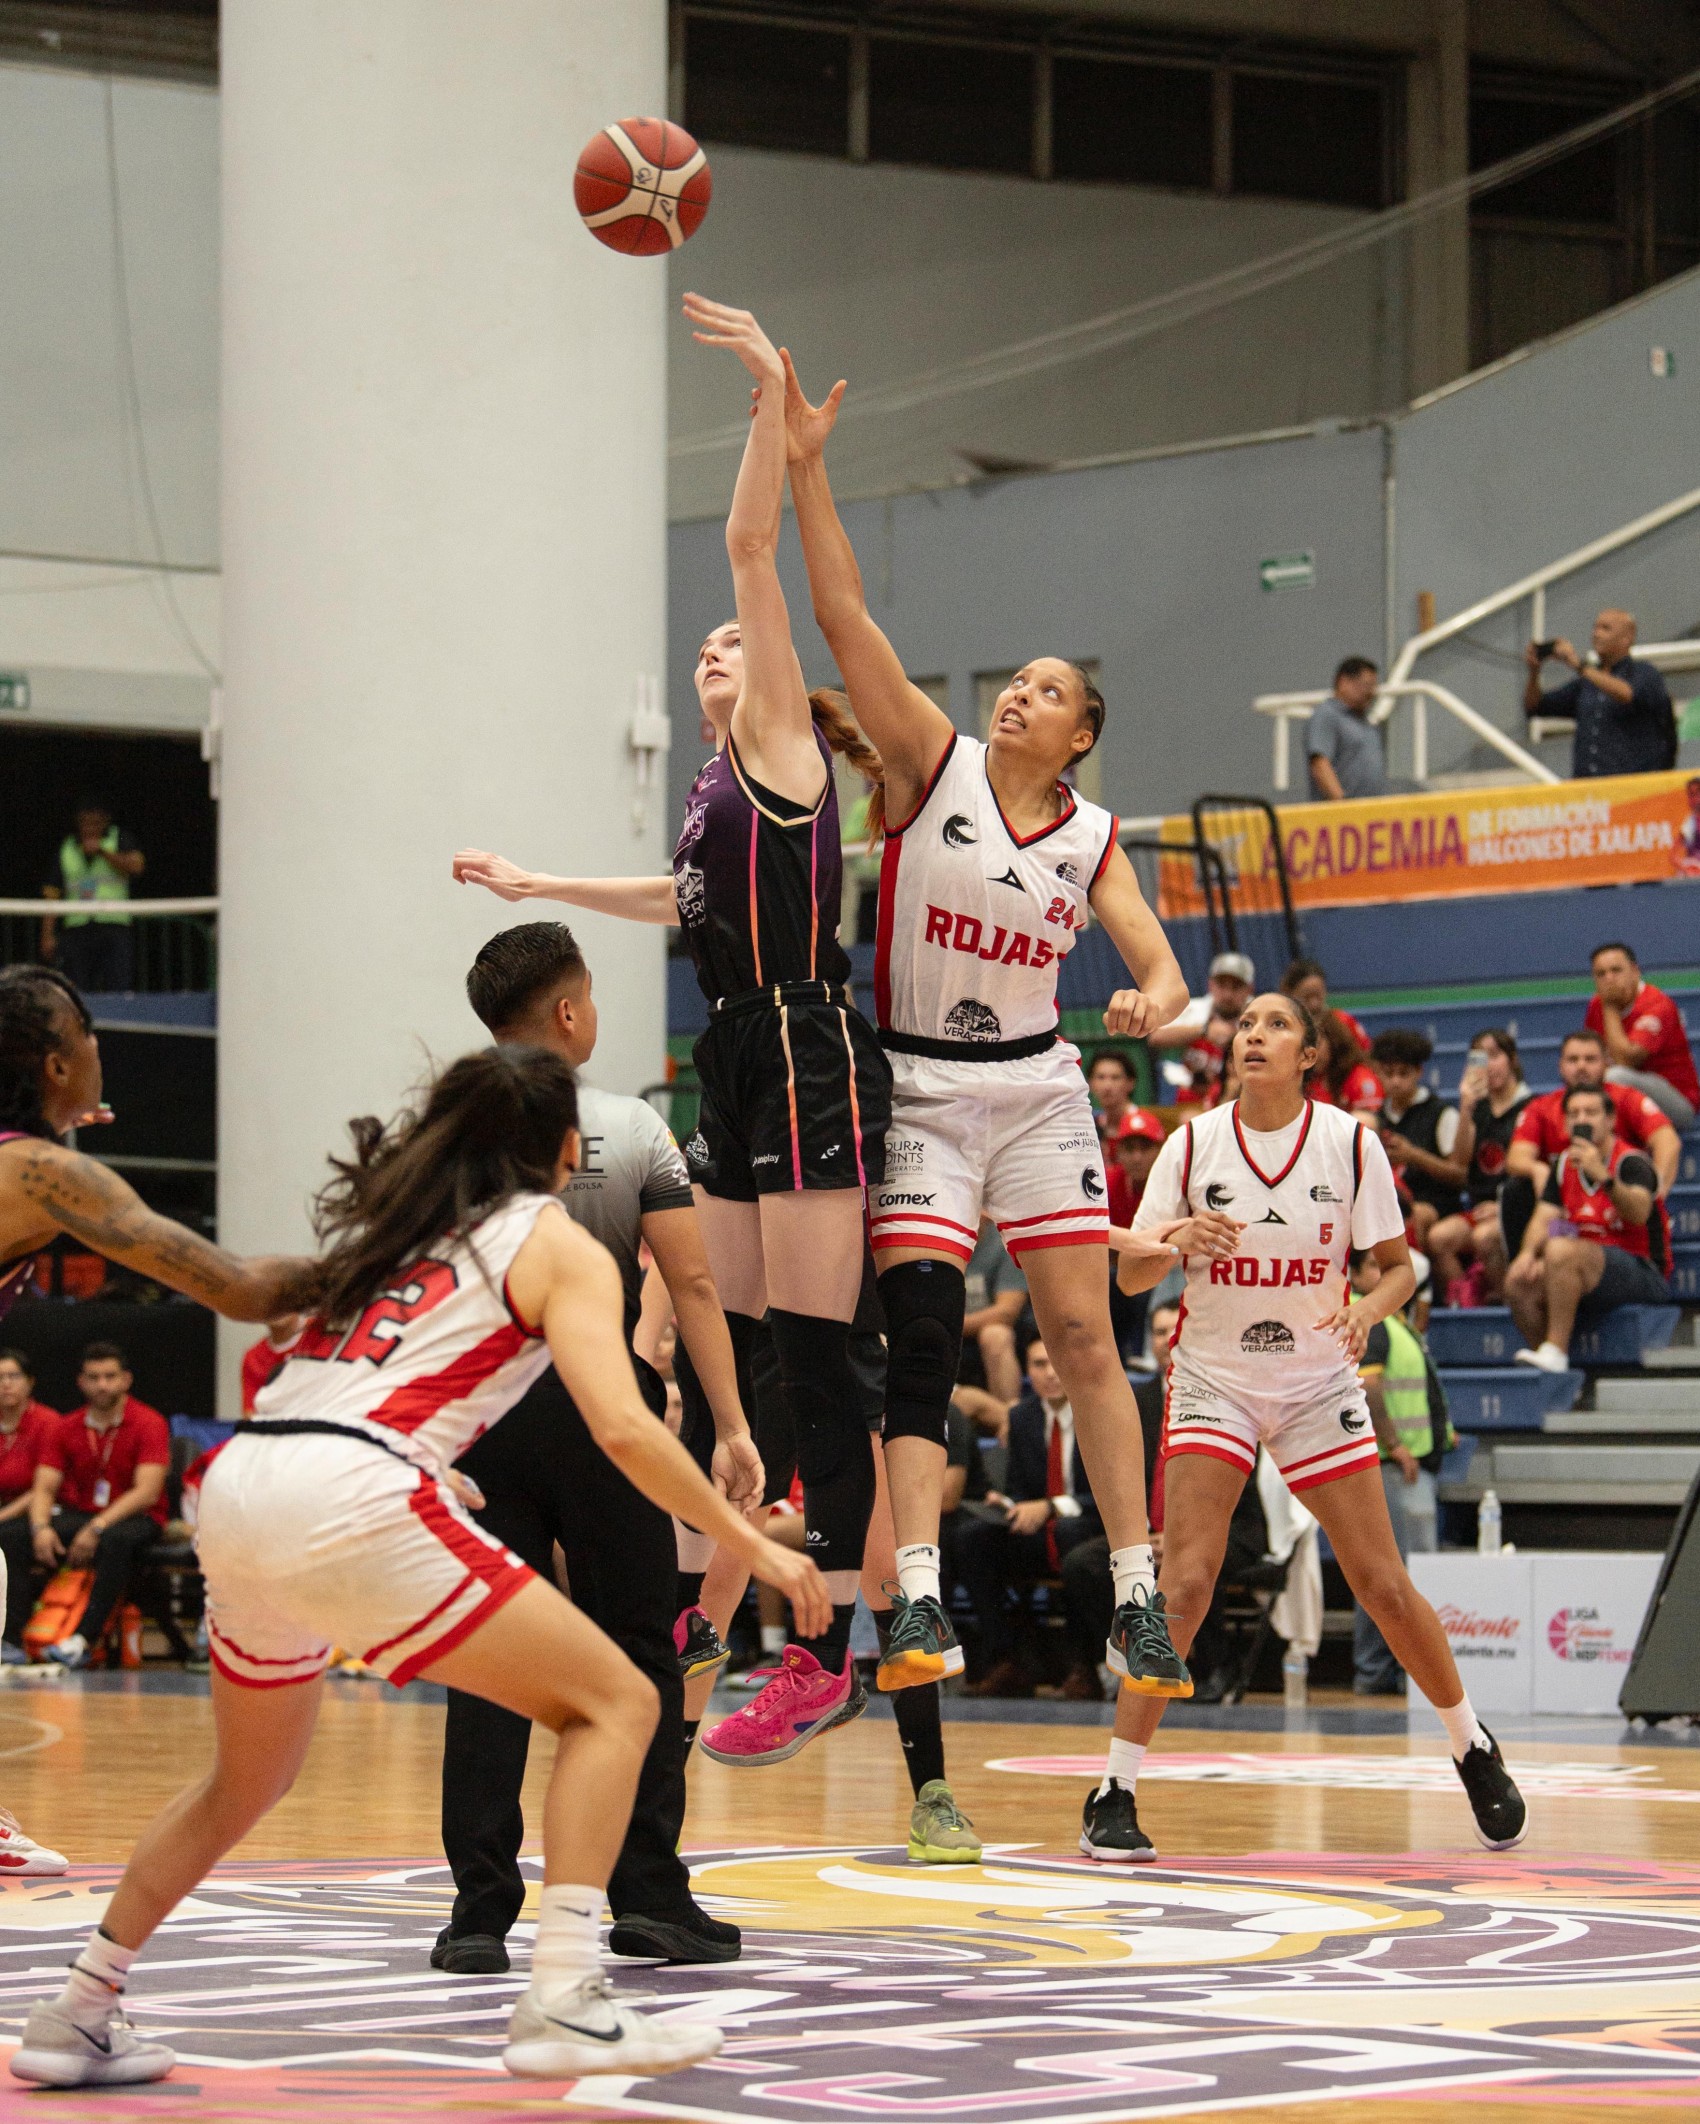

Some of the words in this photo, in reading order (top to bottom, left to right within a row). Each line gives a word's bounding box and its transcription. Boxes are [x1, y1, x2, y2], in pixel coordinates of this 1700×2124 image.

[1044, 896, 1077, 930] 24
[925, 903, 1055, 969] ROJAS
[944, 1025, 1001, 1043] VERACRUZ
[884, 1140, 912, 1153] OUR
[1058, 1139, 1080, 1152] DON
[884, 1152, 924, 1165] OINTS
[573, 1182, 604, 1192] BOLSA
[1319, 1222, 1334, 1245] 5
[1210, 1257, 1331, 1288] ROJAS
[1240, 1344, 1296, 1353] VERACRUZ
